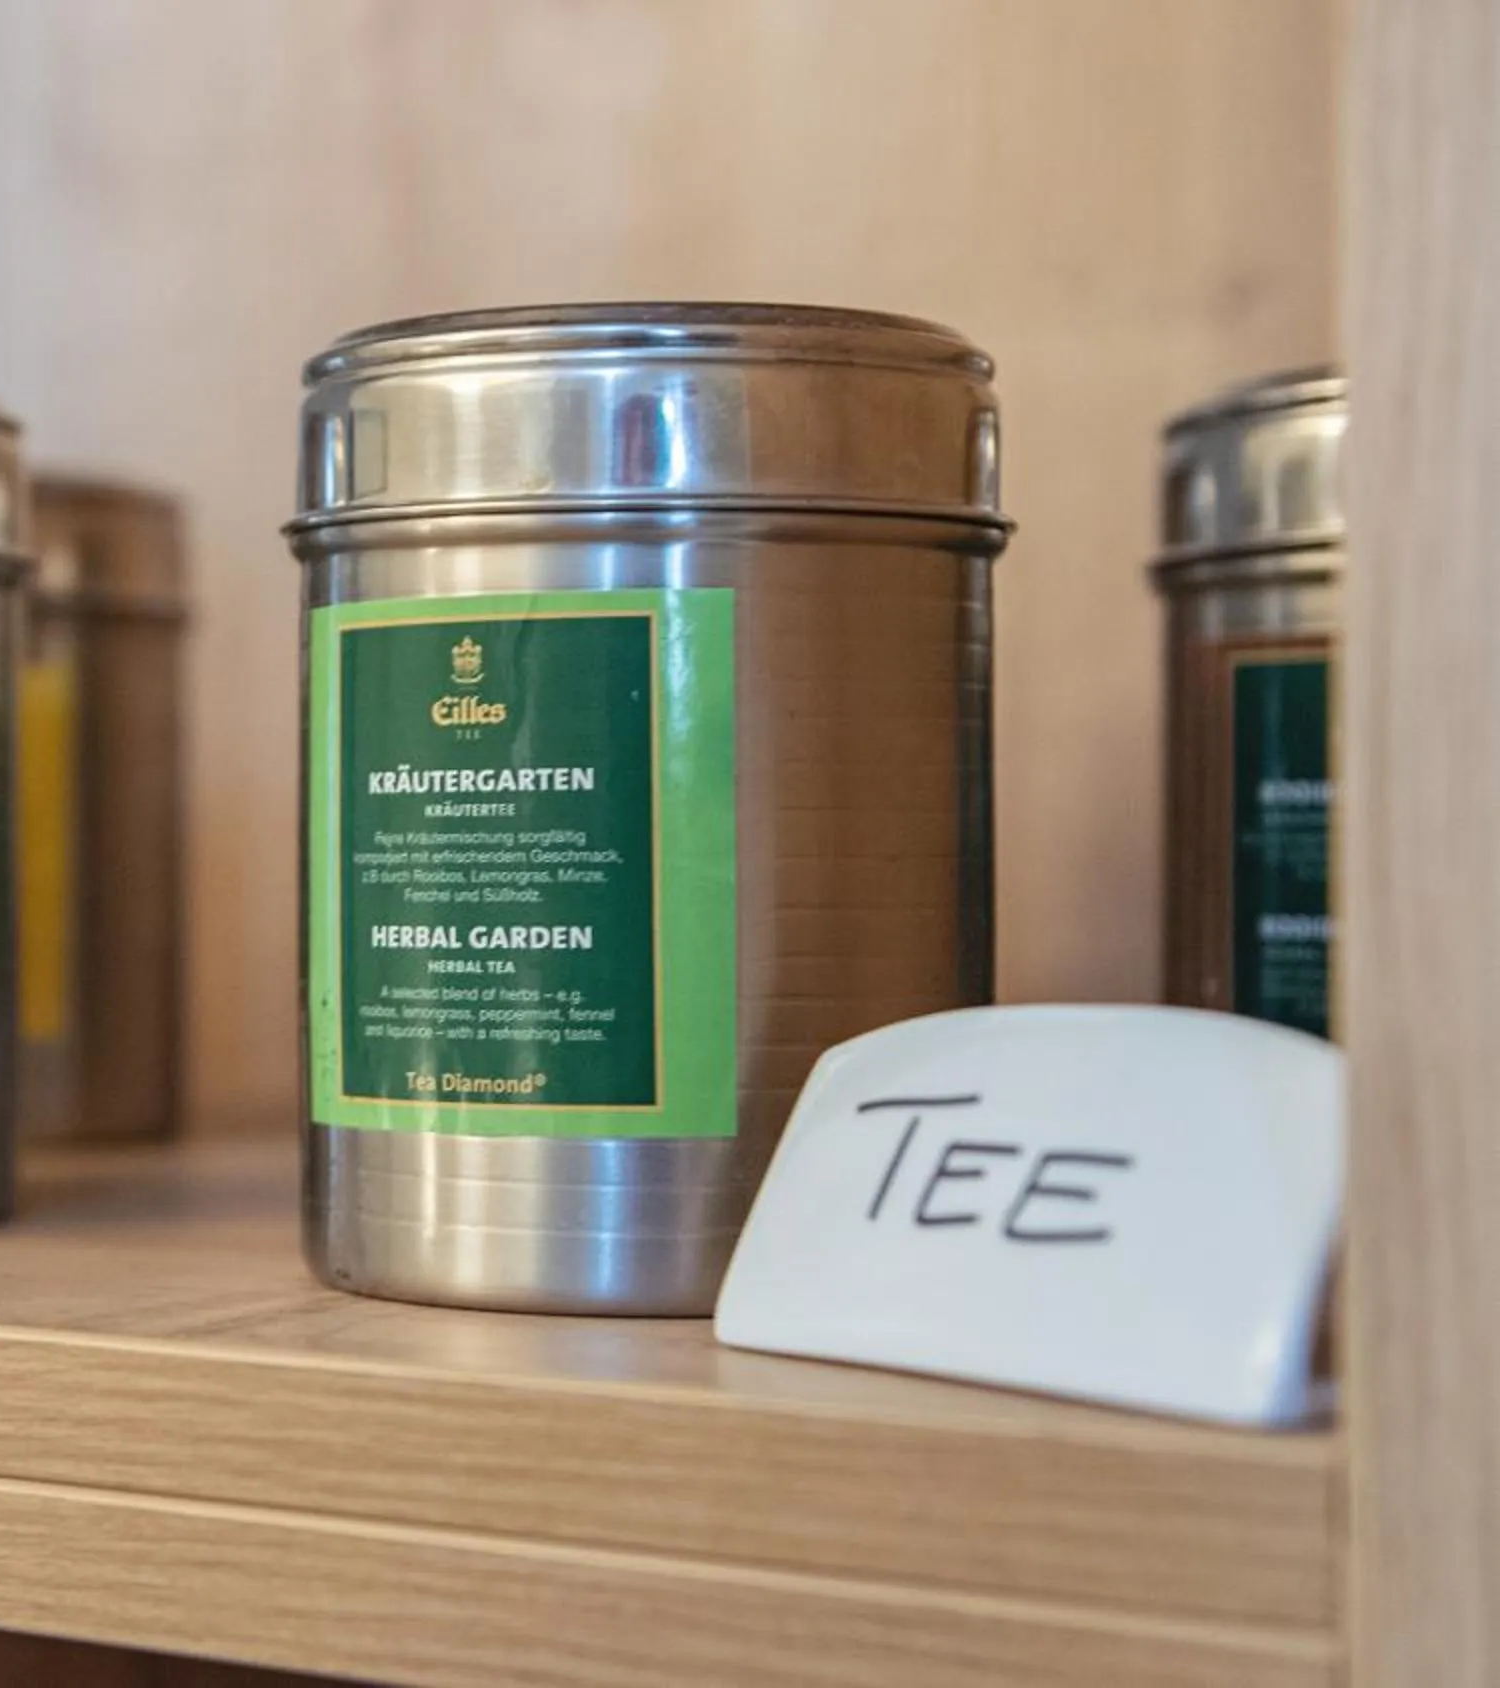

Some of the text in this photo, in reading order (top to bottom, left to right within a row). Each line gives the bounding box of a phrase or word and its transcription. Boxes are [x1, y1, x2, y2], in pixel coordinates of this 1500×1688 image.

[431, 696, 507, 726] Eilles
[456, 729, 481, 740] TEE
[368, 763, 595, 795] KRÄUTERGARTEN
[424, 801, 517, 817] KRÄUTERTEE
[406, 831, 515, 847] Kräutermischung
[518, 829, 587, 847] sorgfältig
[410, 852, 429, 862] mit
[431, 850, 527, 863] erfrischendem
[530, 849, 624, 863] Geschmack,
[452, 888, 480, 902] und
[371, 925, 594, 949] HERBAL GARDEN
[427, 960, 516, 974] HERBAL TEA
[441, 986, 479, 1001] blend
[481, 987, 497, 1001] of
[499, 986, 540, 1001] herbs
[478, 1009, 565, 1022] peppermint,
[568, 1008, 616, 1021] fennel
[446, 1026, 474, 1040] with
[488, 1026, 560, 1045] refreshing
[563, 1028, 608, 1041] taste.
[405, 1072, 436, 1090] Tea
[857, 1094, 1136, 1242] TEE
